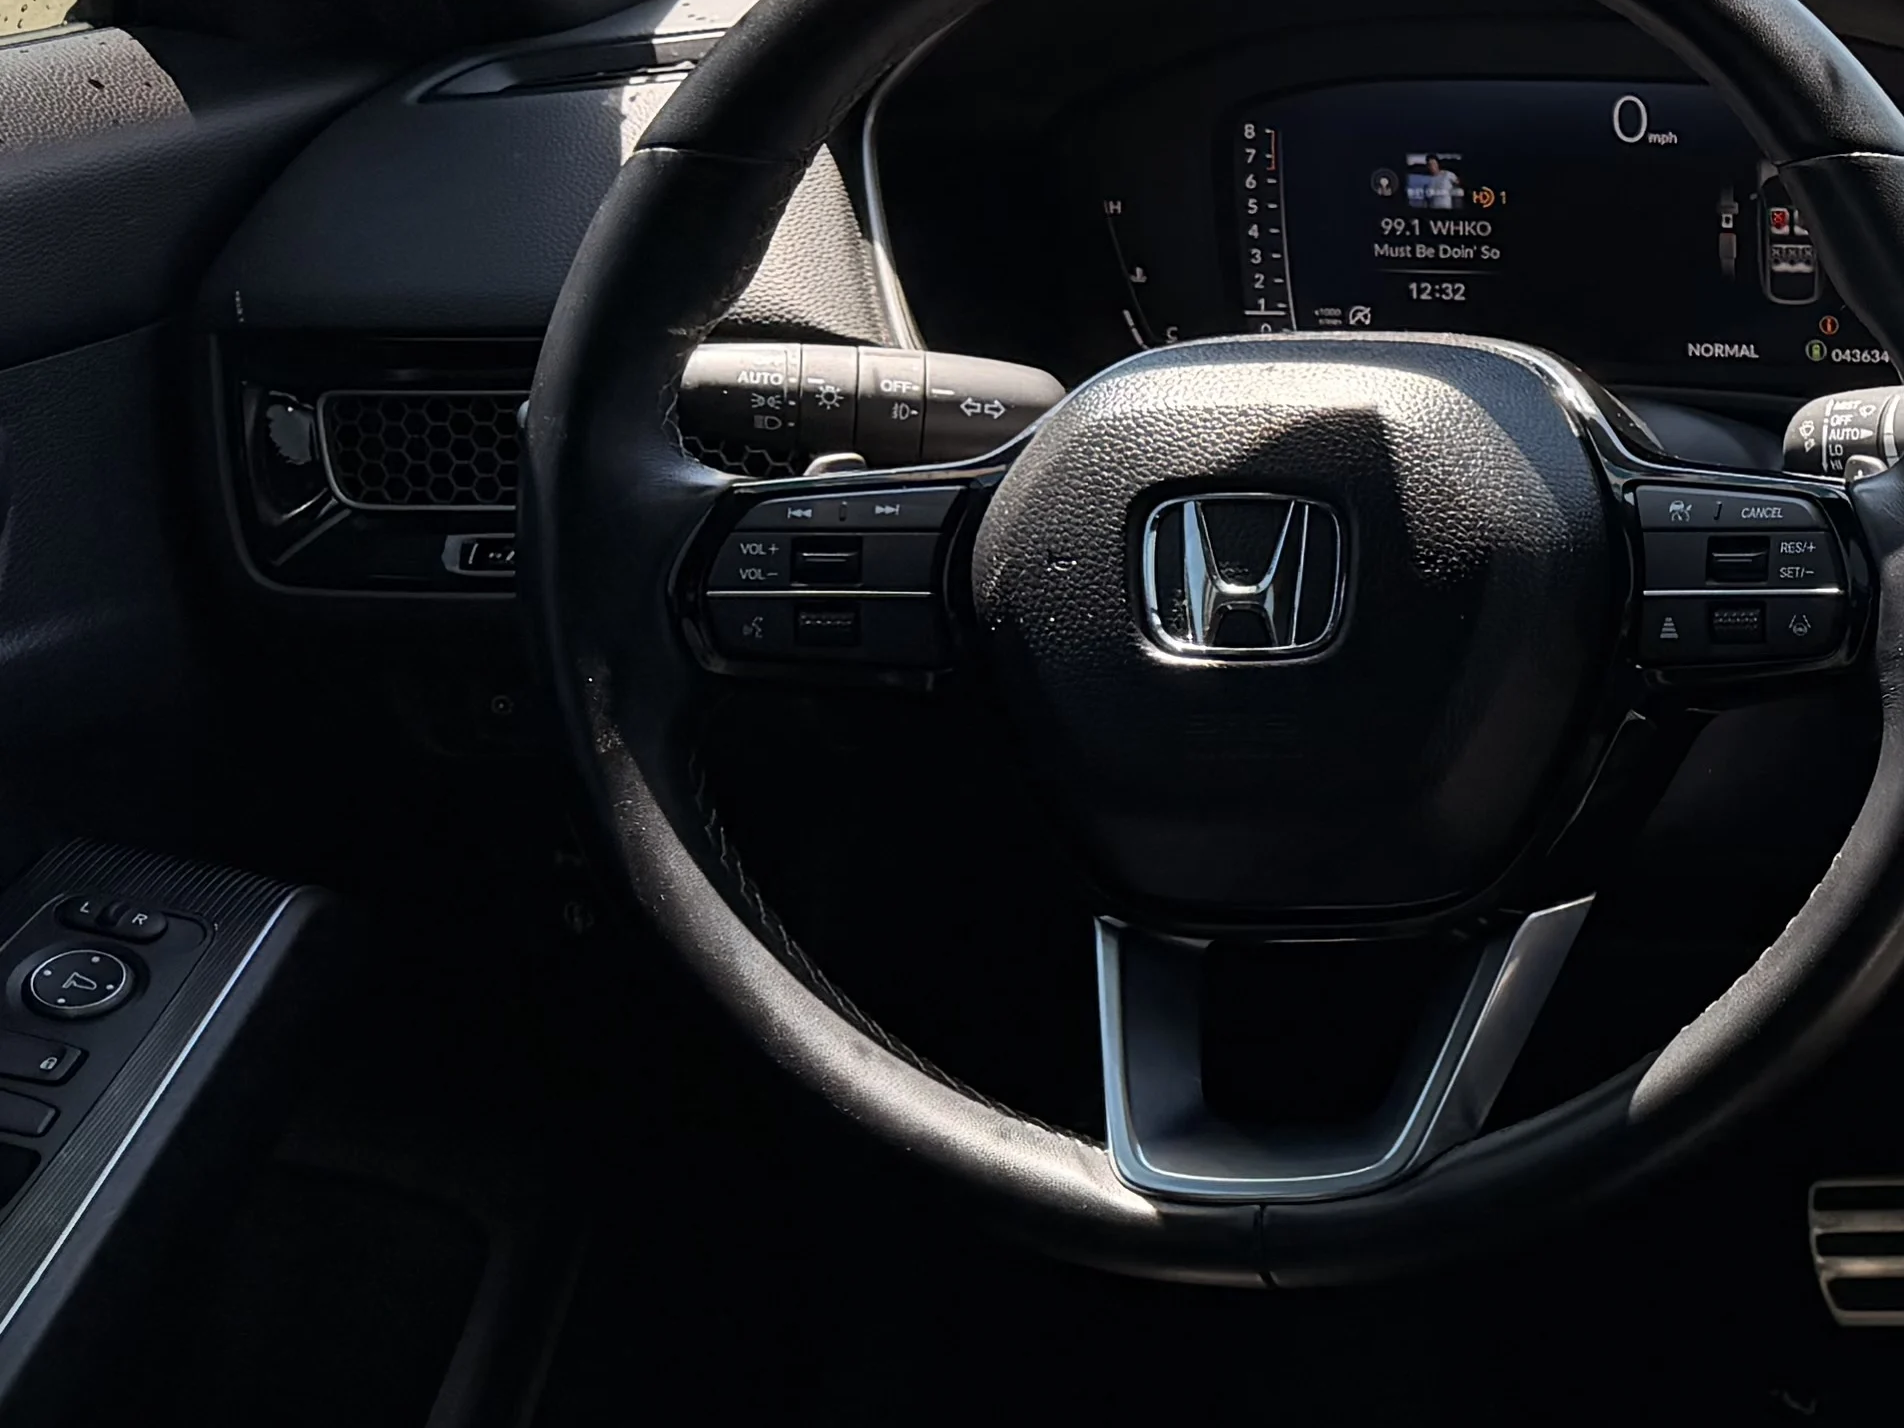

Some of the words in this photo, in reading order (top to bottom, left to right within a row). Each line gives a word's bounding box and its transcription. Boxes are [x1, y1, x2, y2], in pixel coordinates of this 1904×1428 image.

[1612, 93, 1648, 144] 0
[1647, 131, 1678, 146] mph
[1243, 123, 1256, 140] 8
[1244, 149, 1256, 164] 7
[1245, 174, 1257, 190] 6
[1246, 199, 1259, 215] 5
[1247, 224, 1260, 239] 4
[1381, 218, 1421, 237] 99.1
[1430, 220, 1492, 237] WHKO
[1250, 249, 1262, 264] 3
[1374, 243, 1412, 259] Must
[1416, 244, 1436, 259] Be
[1439, 244, 1477, 259] Doin'
[1480, 245, 1501, 260] So
[1253, 274, 1266, 289] 2
[1408, 282, 1466, 302] 12:32
[1256, 297, 1265, 313] 1
[1687, 342, 1759, 359] NORMAL
[1831, 348, 1890, 364] 043634
[737, 371, 784, 386] AUTO
[880, 379, 913, 394] OFF
[1830, 414, 1853, 427] OFF
[1828, 427, 1860, 440] AUTO
[1828, 443, 1843, 457] LO
[1741, 507, 1784, 519] CANCEL
[80, 902, 89, 913] L
[131, 913, 148, 925] R
